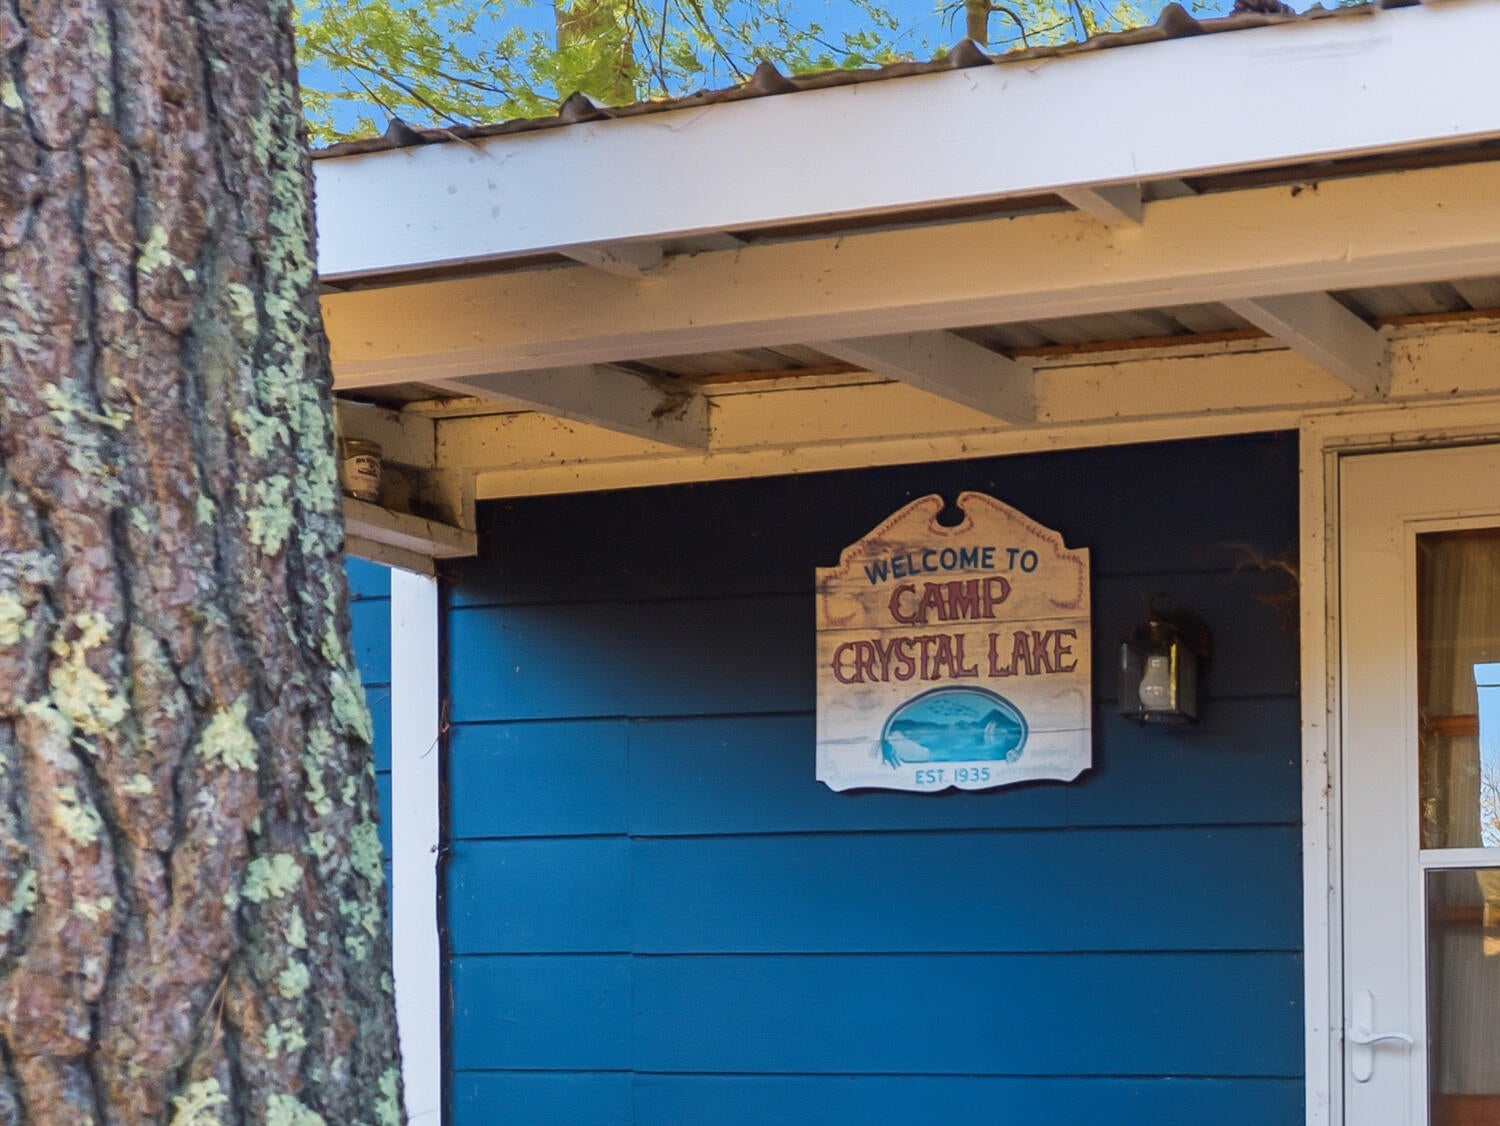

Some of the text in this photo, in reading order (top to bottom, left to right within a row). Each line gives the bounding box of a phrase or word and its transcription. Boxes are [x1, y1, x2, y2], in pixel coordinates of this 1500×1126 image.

[864, 546, 1039, 585] WELCOME TO
[888, 576, 1012, 625] CAMP
[831, 628, 1079, 684] CRYSTAL LAKE
[954, 767, 990, 782] 1935
